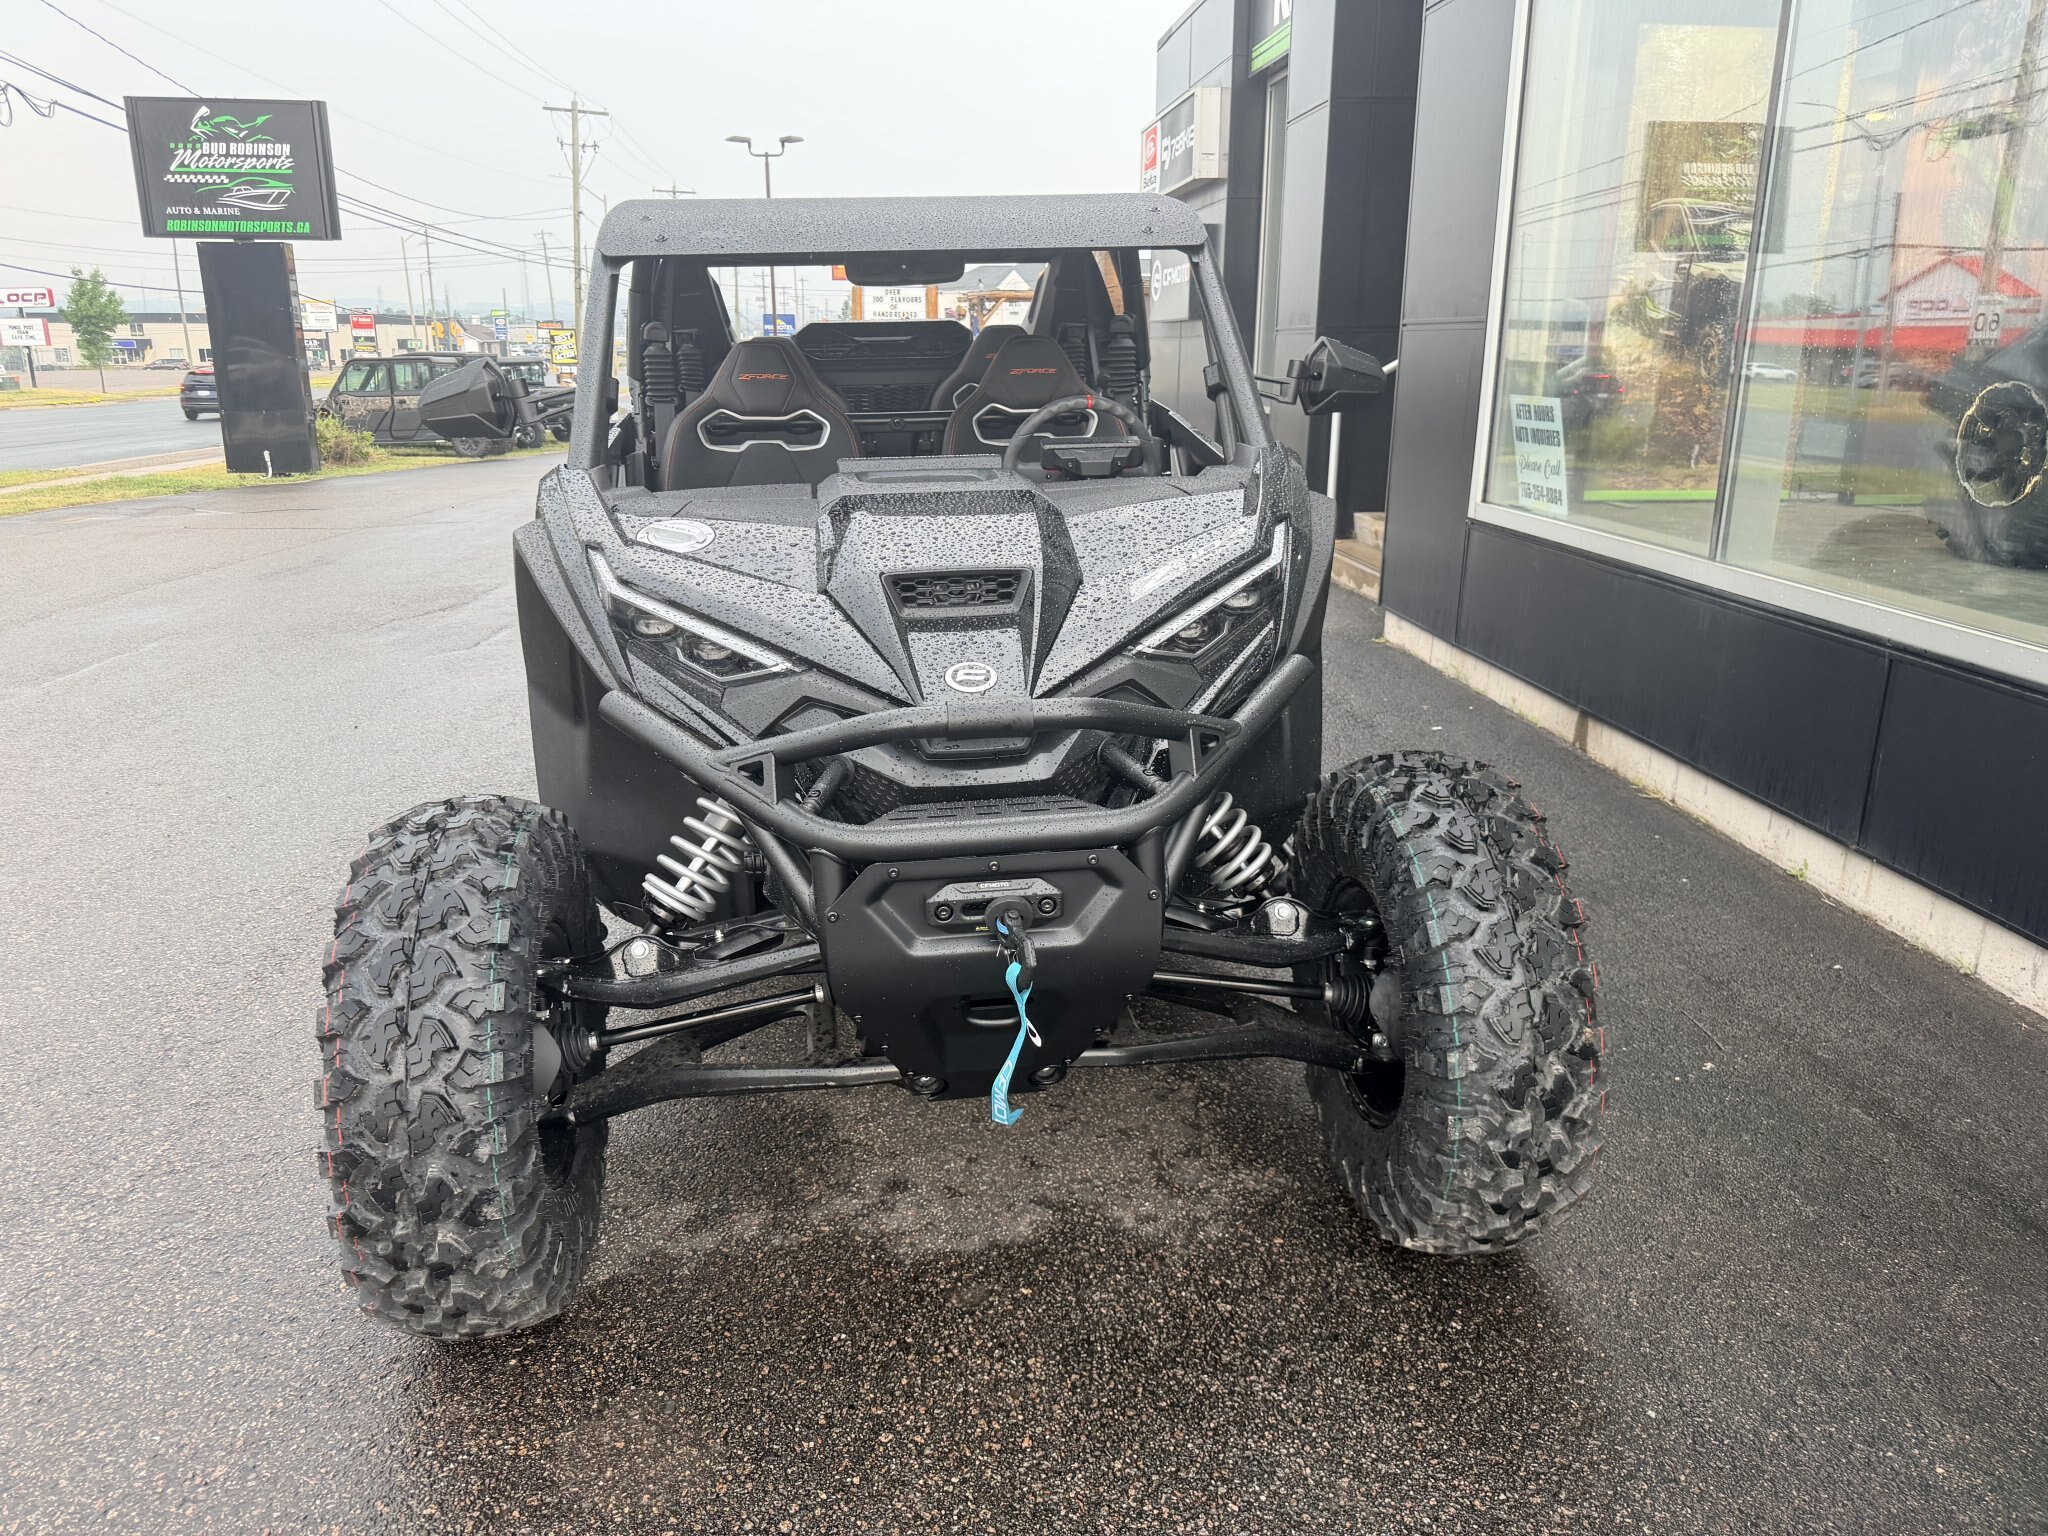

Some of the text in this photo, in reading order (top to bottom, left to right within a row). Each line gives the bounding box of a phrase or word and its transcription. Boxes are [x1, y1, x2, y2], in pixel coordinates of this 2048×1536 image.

[203, 142, 291, 156] BUD ROBINSON
[170, 148, 295, 172] Motorsports
[166, 207, 241, 216] AUTO & MARINE
[166, 219, 310, 233] ROBINSONMOTORSPORTS.CA
[7, 293, 47, 302] OCP
[738, 373, 788, 381] ZFORCE
[1533, 405, 1555, 423] HOURS
[1519, 454, 1561, 480] Please Call
[980, 881, 1009, 889] CFMOTO
